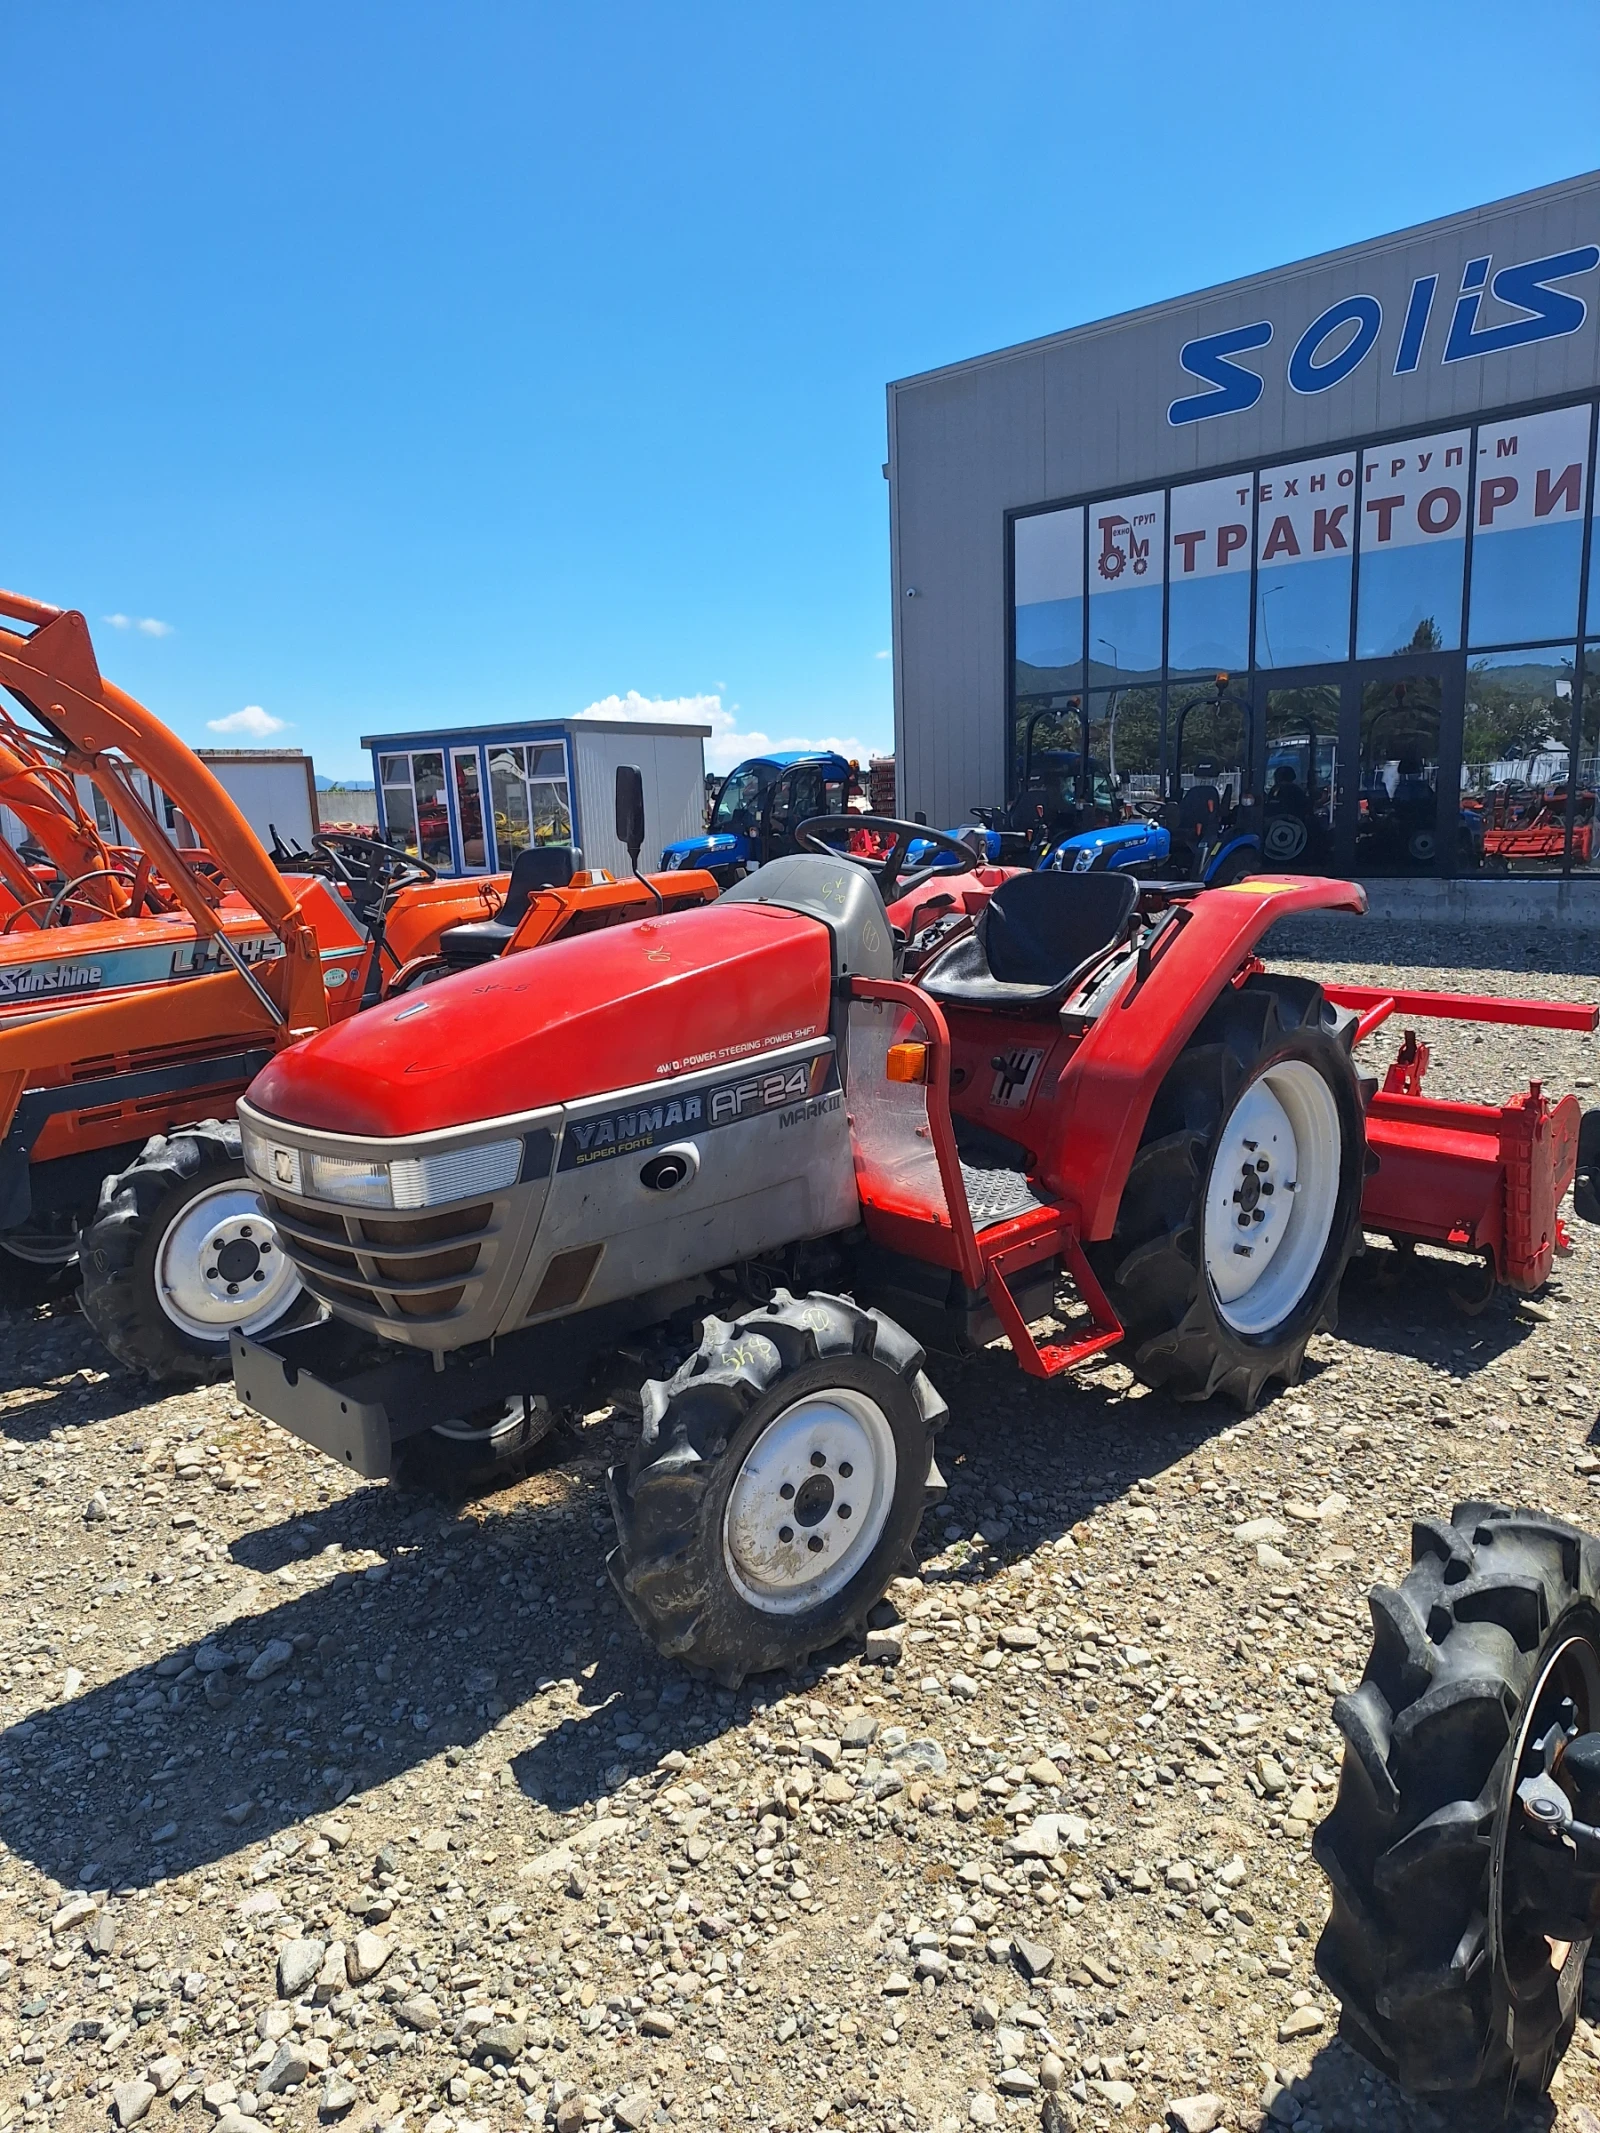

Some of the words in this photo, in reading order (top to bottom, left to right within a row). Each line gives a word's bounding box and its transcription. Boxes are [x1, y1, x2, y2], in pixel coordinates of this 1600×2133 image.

[1174, 462, 1583, 573] ТРАКТОРИ
[0, 963, 103, 996] Sunshine
[682, 1051, 717, 1067] POWER
[718, 1039, 761, 1059] STEERING
[794, 1024, 817, 1039] SHIFT
[571, 1095, 702, 1150] YANMAR
[575, 1146, 617, 1165] SUPER
[617, 1135, 655, 1154] FORTE
